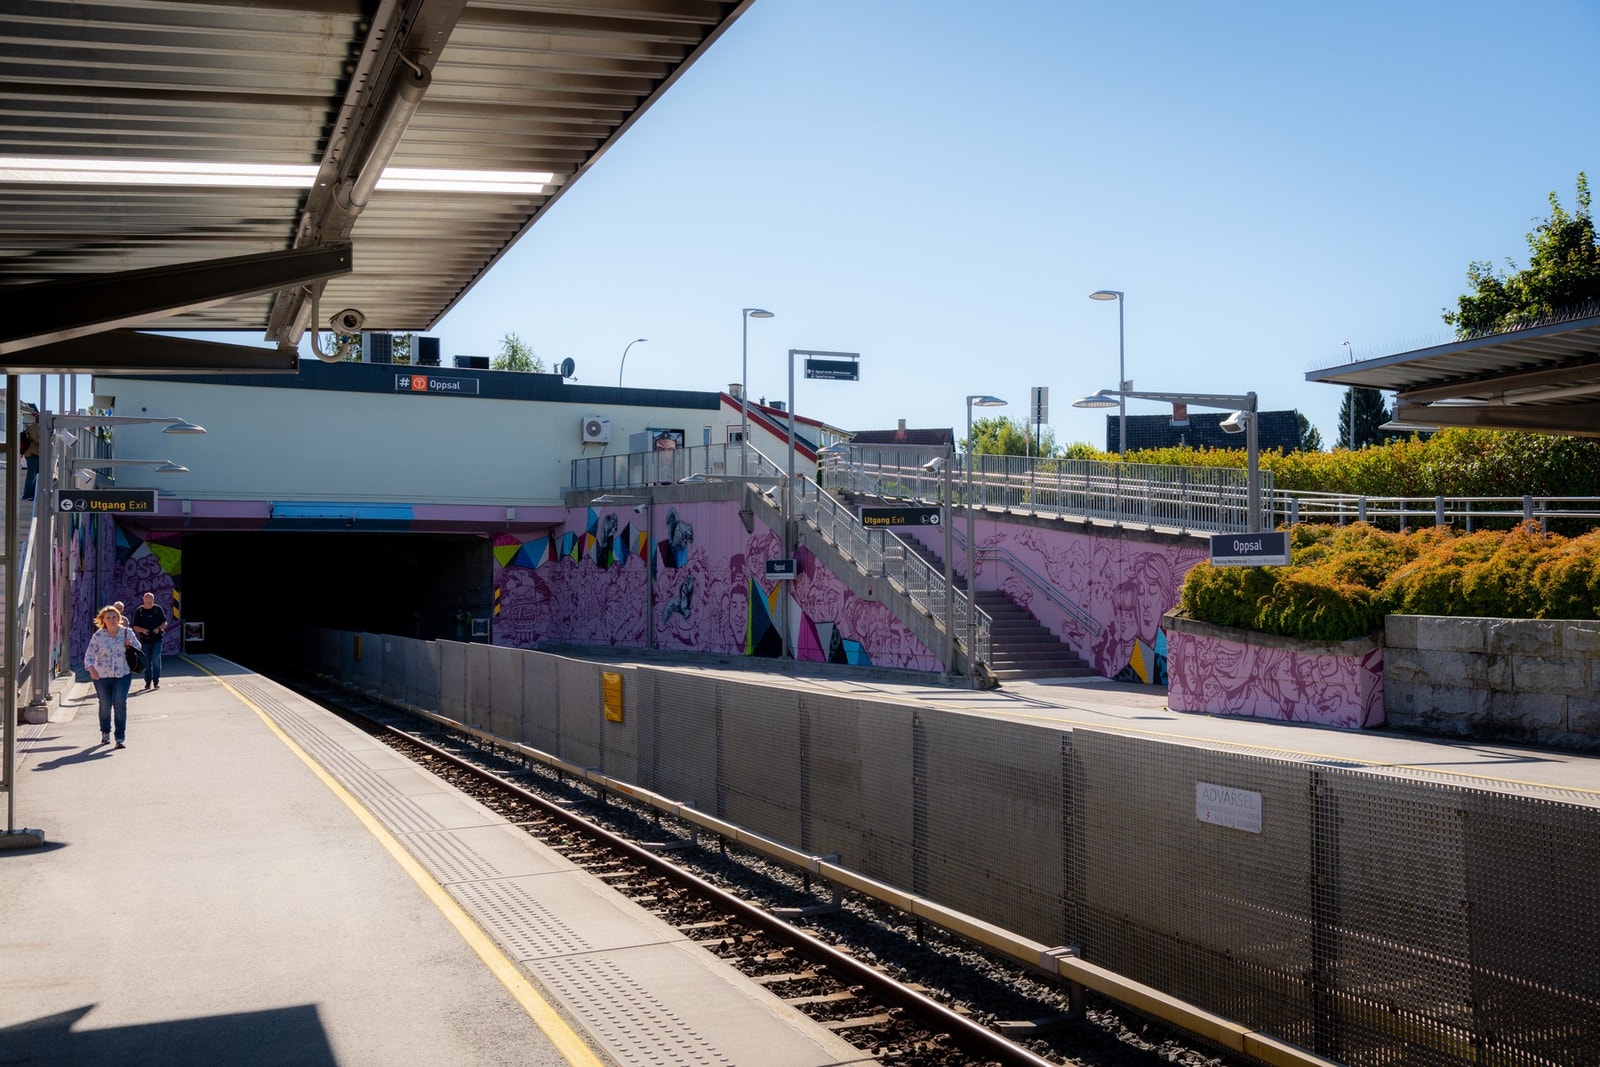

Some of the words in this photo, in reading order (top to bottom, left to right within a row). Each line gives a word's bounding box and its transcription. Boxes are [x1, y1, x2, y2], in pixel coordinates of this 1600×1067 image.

[429, 380, 461, 390] Oppsal
[90, 500, 126, 511] Utgang
[129, 501, 148, 509] Exit
[864, 517, 890, 525] Utgang
[1233, 539, 1262, 554] Oppsal
[1202, 787, 1256, 810] ADVARSEL
